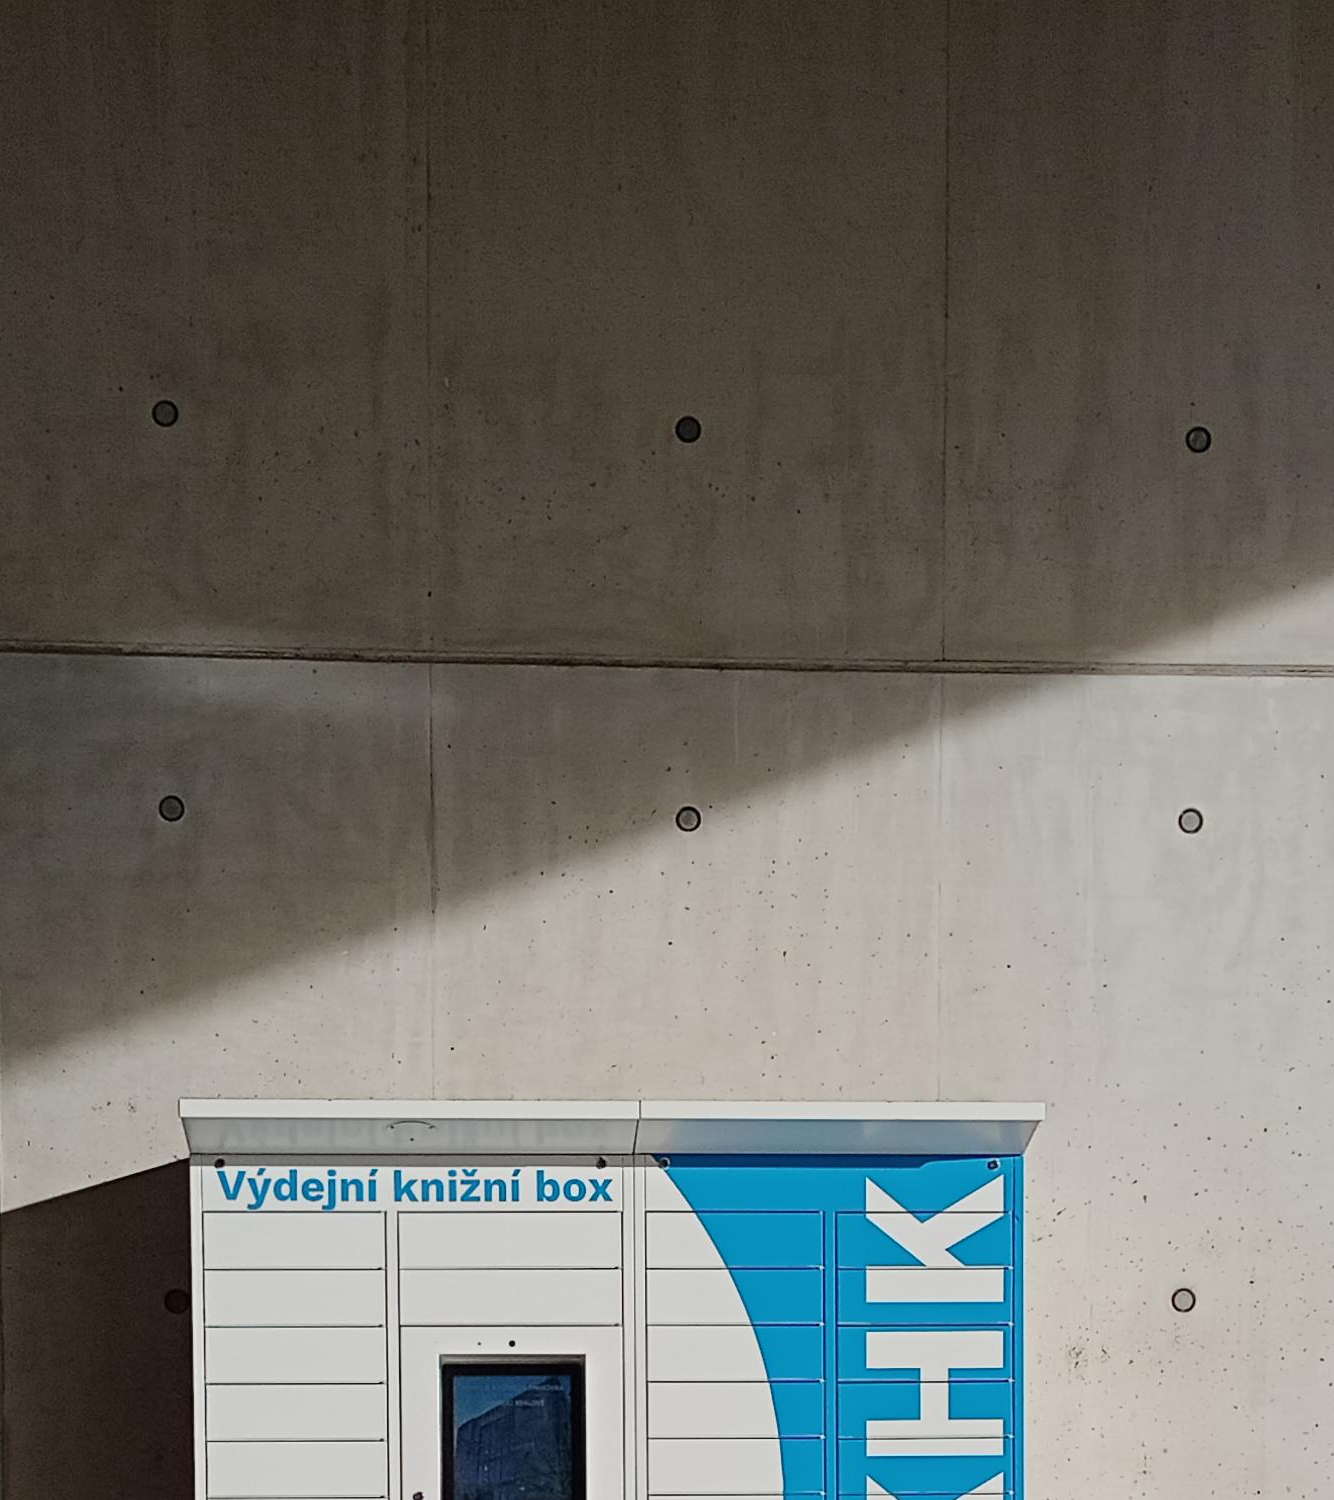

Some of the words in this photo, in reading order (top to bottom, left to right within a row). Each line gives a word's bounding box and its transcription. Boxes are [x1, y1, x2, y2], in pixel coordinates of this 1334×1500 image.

[217, 1168, 379, 1212] Výdejní
[393, 1168, 521, 1202] knižní
[536, 1169, 613, 1202] box
